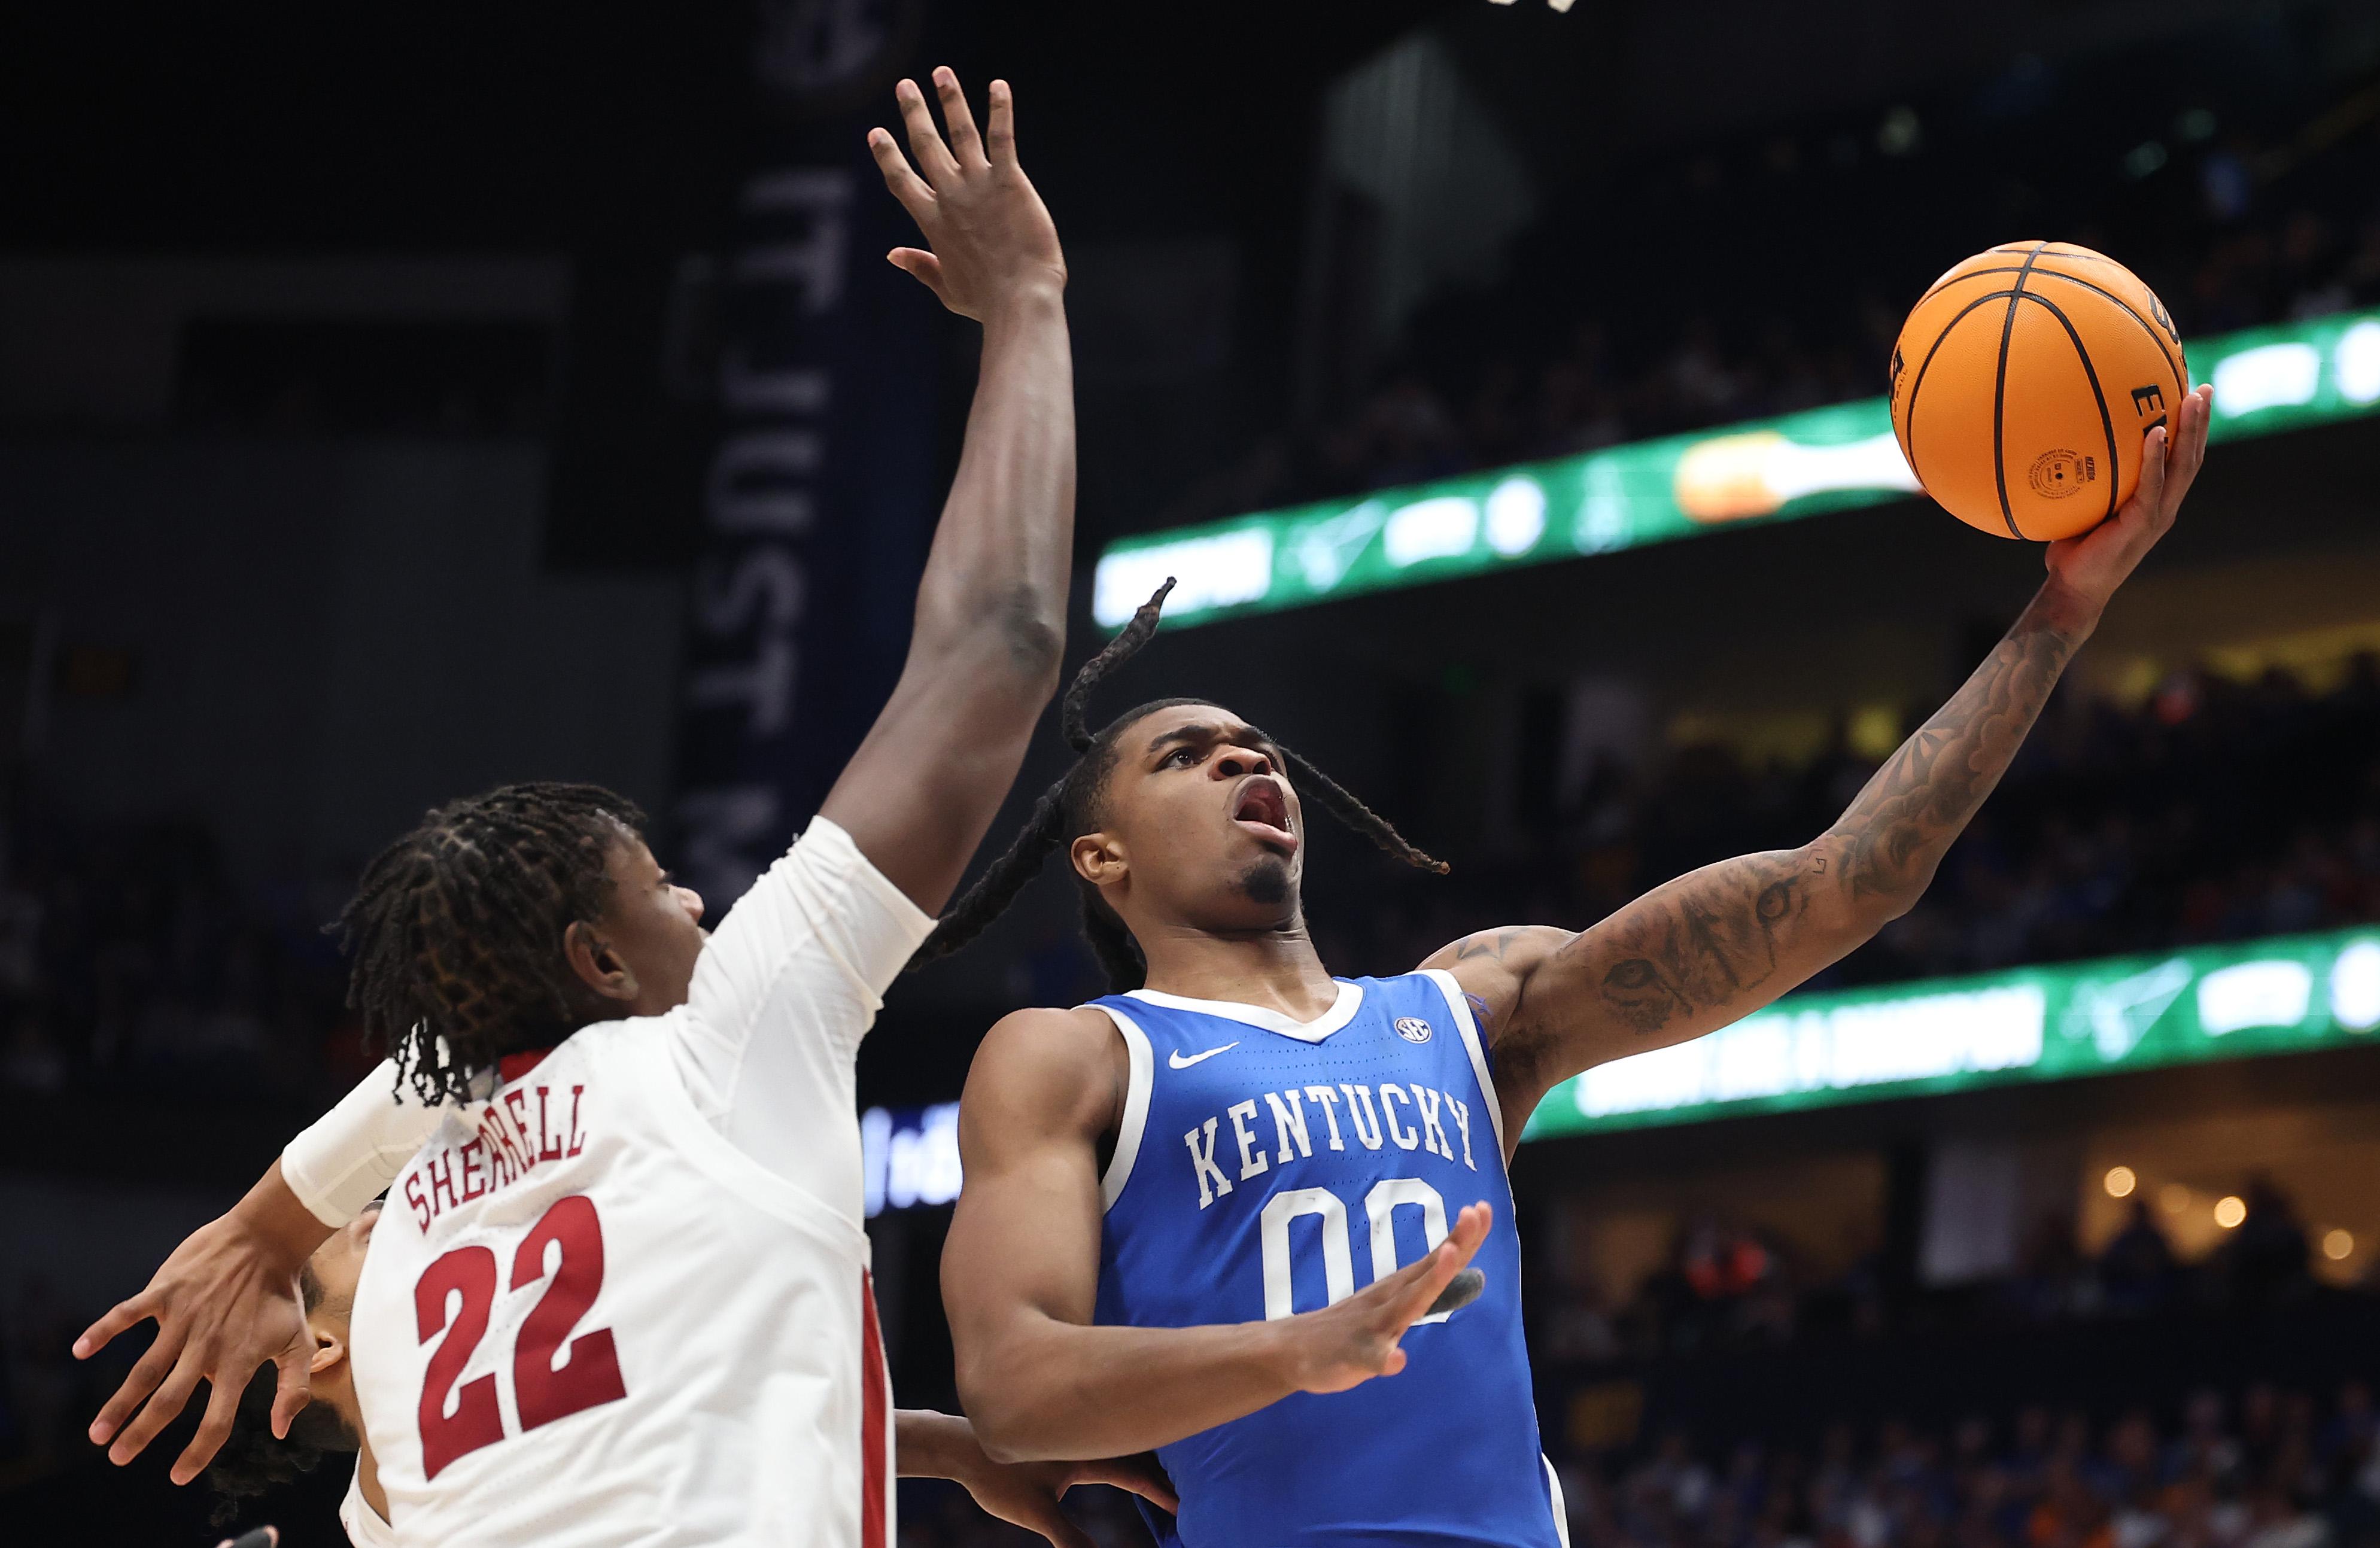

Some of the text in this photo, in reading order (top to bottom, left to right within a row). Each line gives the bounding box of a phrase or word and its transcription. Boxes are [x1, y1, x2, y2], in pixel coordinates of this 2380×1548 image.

[689, 351, 830, 733] JUST
[1397, 1018, 1429, 1041] SEC
[405, 1085, 587, 1235] SHERRELL
[1184, 1083, 1478, 1210] KENTUCKY
[1260, 1178, 1453, 1326] 00
[415, 1195, 627, 1482] 22
